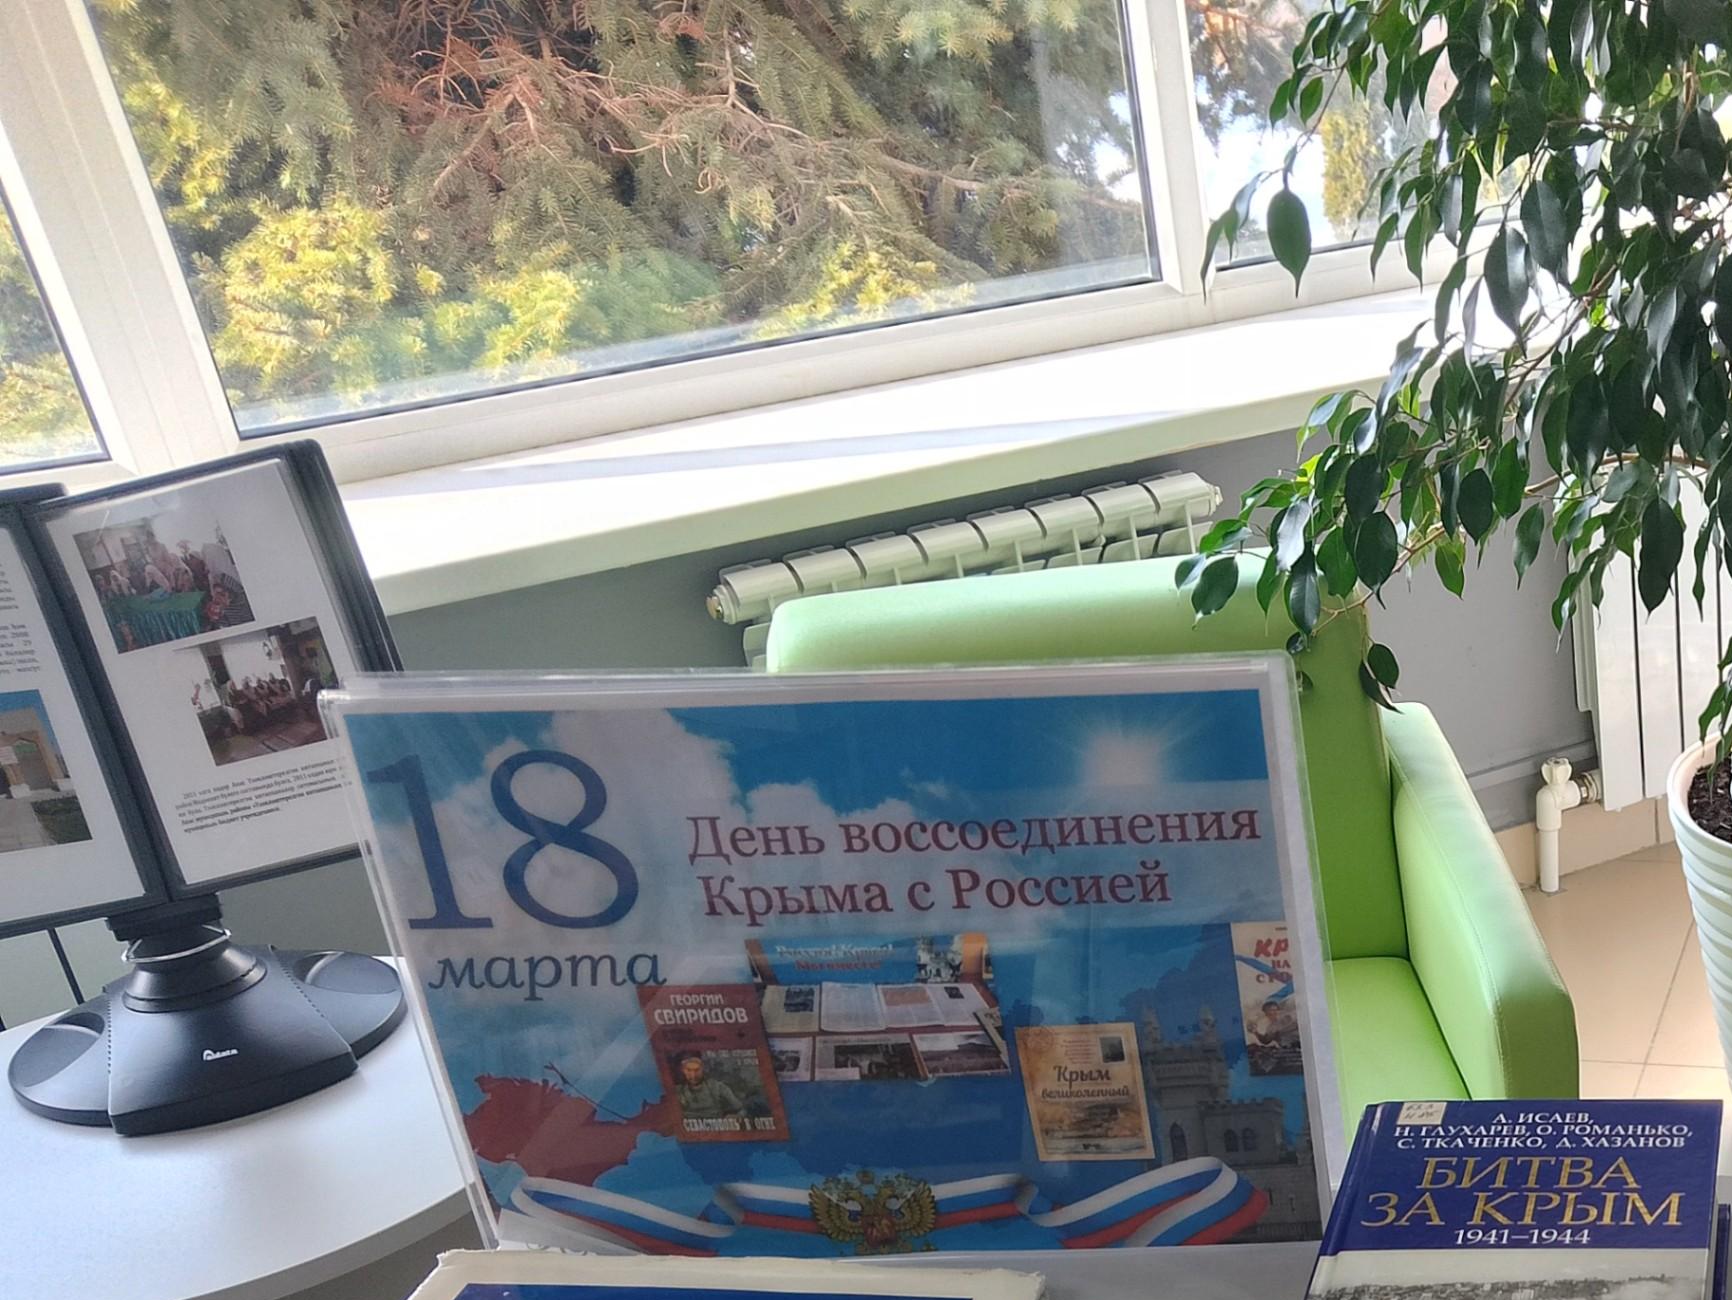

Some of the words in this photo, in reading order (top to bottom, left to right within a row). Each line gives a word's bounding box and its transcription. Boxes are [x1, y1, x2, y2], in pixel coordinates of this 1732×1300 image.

[366, 748, 642, 931] 18
[687, 814, 826, 866] День
[842, 805, 1262, 856] воссоединения
[701, 873, 895, 929] Крыма
[908, 882, 934, 912] с
[947, 859, 1173, 912] Россией
[428, 945, 668, 1001] марта
[654, 1007, 749, 1025] СВИРИДОВ
[1053, 1064, 1111, 1090] Крым
[1393, 1126, 1414, 1137] Н.
[1420, 1126, 1530, 1138] ГЛУХАРЕВ,
[1537, 1125, 1558, 1136] О.
[1563, 1125, 1694, 1138] РОМАНЬКО,
[1492, 1113, 1512, 1124] А.
[1519, 1112, 1594, 1125] ИСАЕВ,
[1396, 1138, 1416, 1149] С.
[1421, 1137, 1548, 1150] ТКАЧЕНКО,
[1556, 1138, 1577, 1149] Д.
[1582, 1137, 1687, 1148] ХАЗАНОВ
[1416, 1156, 1642, 1190] БИТВА
[1360, 1192, 1446, 1227] ЗА
[1466, 1192, 1686, 1226] КРЫМ
